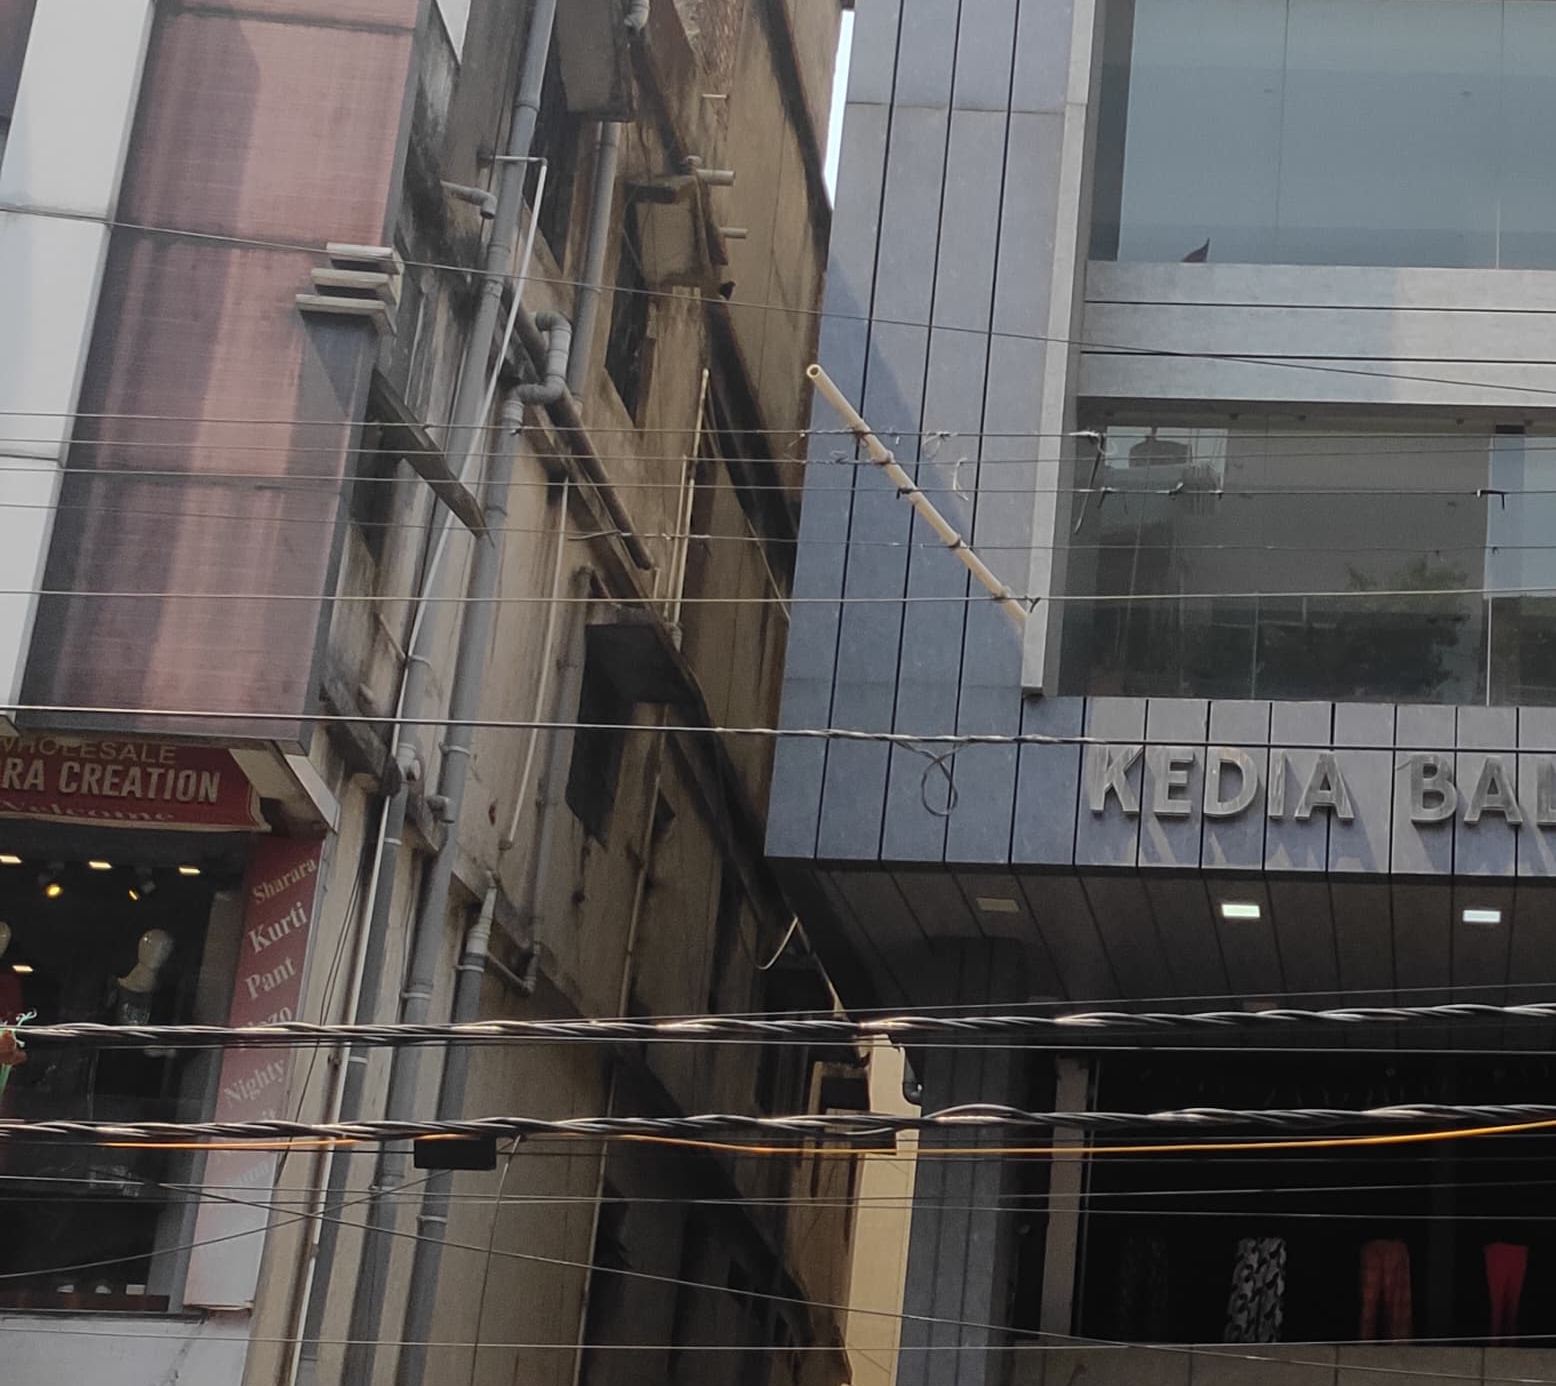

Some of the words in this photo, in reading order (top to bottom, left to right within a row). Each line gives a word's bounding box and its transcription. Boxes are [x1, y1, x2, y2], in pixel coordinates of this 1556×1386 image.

[59, 761, 221, 804] CREATION
[1089, 744, 1355, 821] KEDIA
[252, 858, 318, 904] Sharara
[248, 901, 308, 954] Kurti
[244, 956, 297, 1000] Pant
[223, 1059, 286, 1109] Nighty
